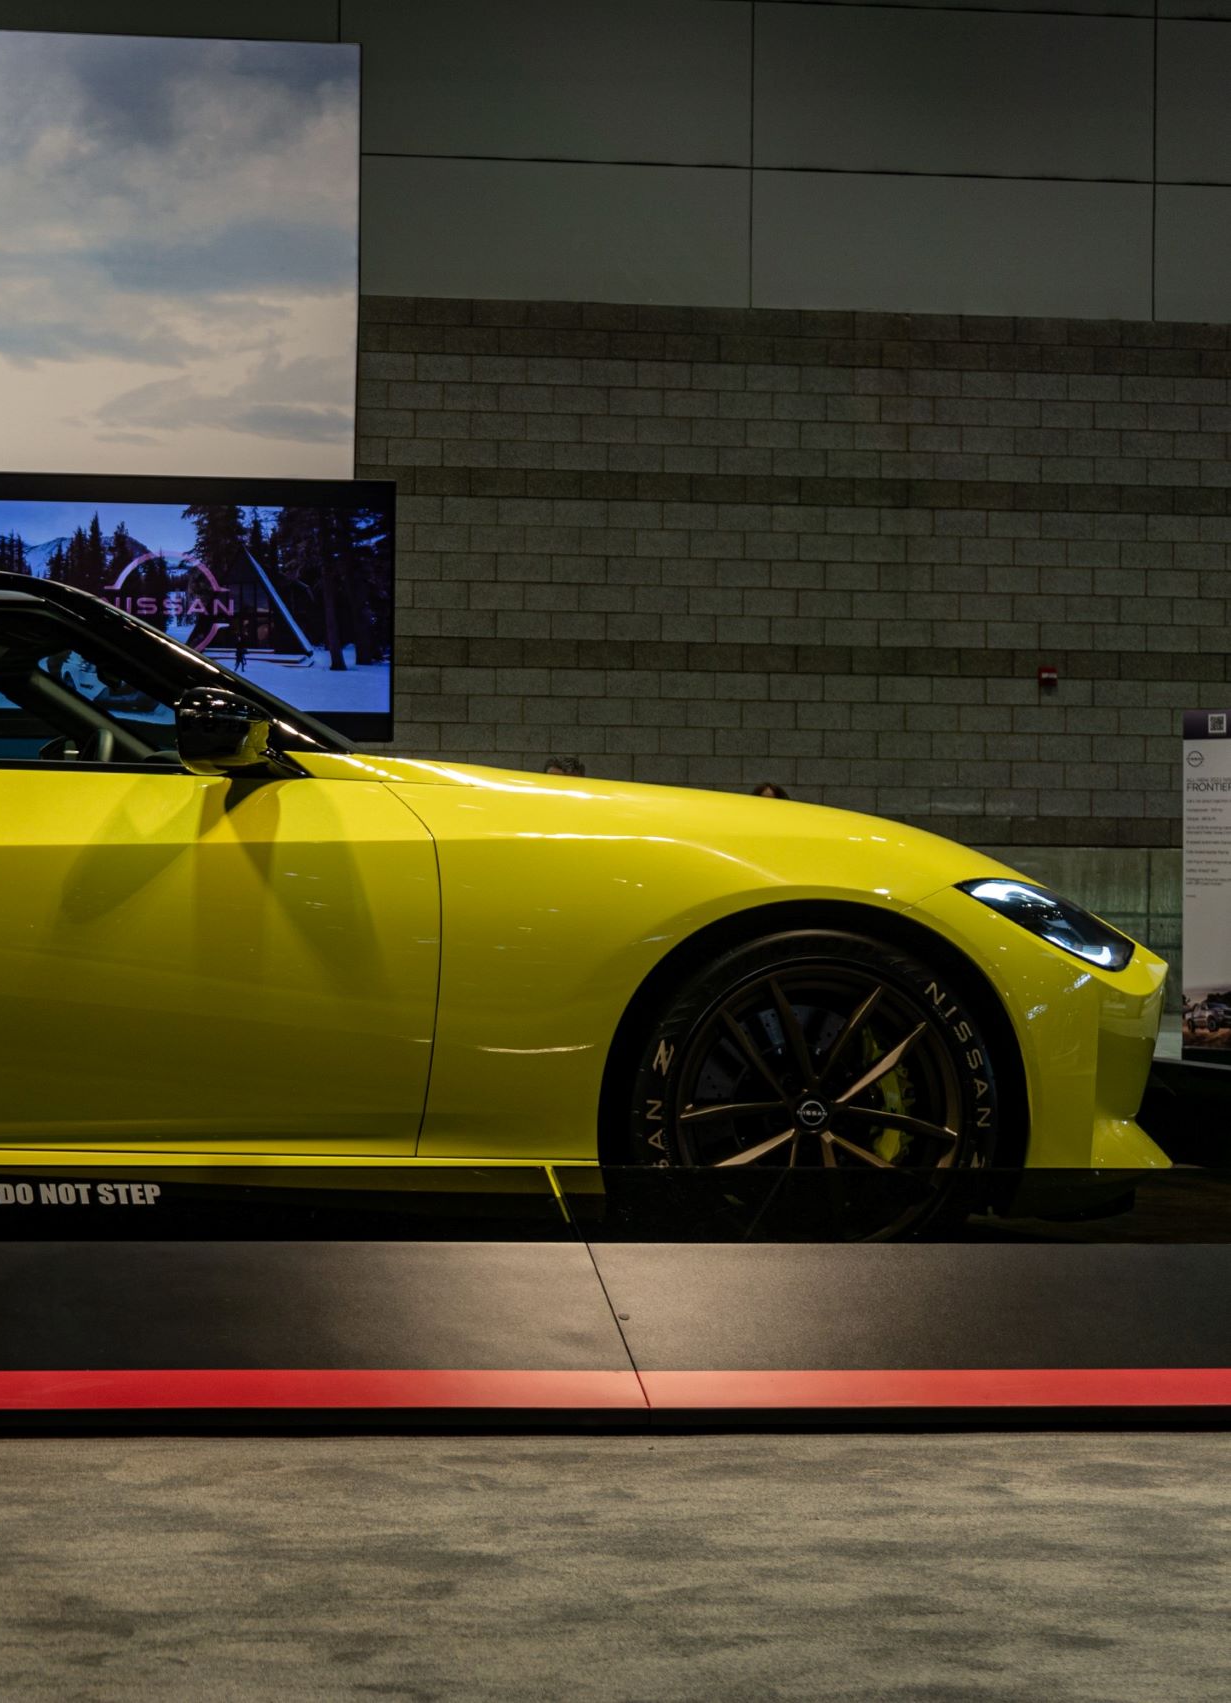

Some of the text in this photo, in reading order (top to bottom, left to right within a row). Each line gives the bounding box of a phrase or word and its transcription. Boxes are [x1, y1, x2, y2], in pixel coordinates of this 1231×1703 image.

[923, 981, 992, 1129] NISSAN
[39, 1183, 91, 1205] NOT
[97, 1183, 161, 1205] STEP
